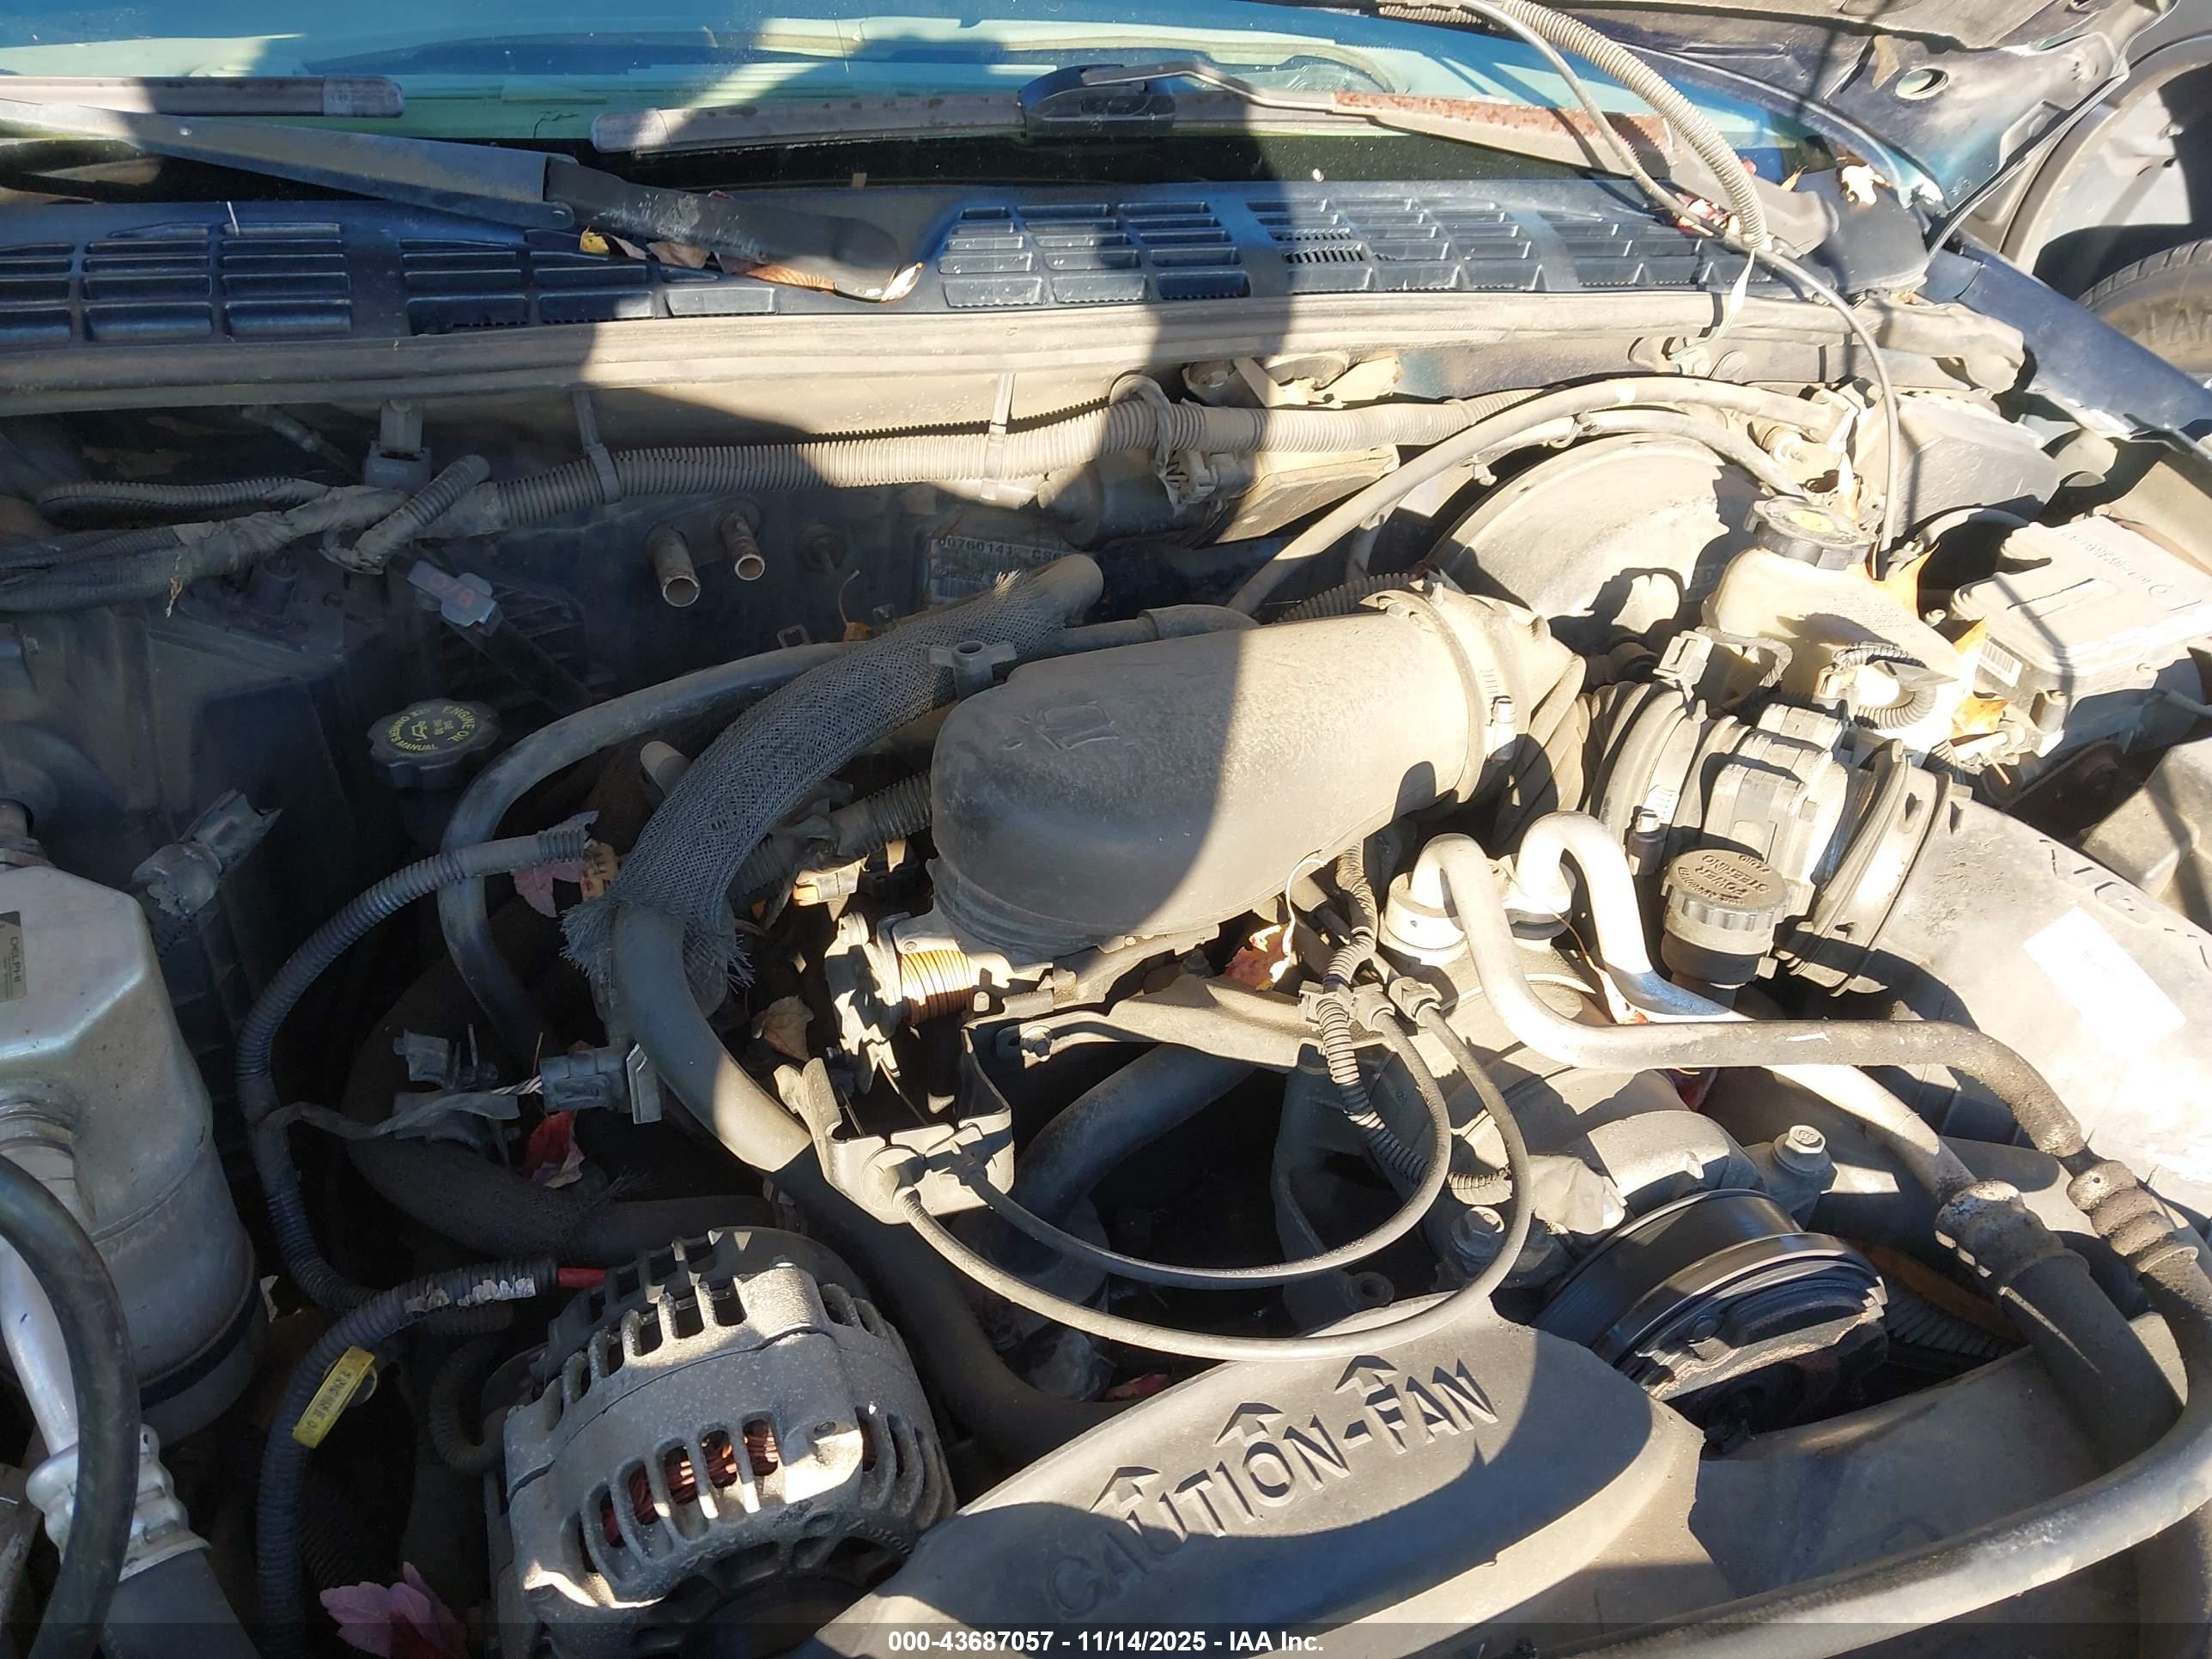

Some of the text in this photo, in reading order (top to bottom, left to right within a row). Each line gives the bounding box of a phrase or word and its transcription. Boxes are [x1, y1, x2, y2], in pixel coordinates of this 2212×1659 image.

[394, 741, 440, 751] MANUAL
[1694, 866, 1748, 895] POWER
[1701, 854, 1771, 894] STEERING
